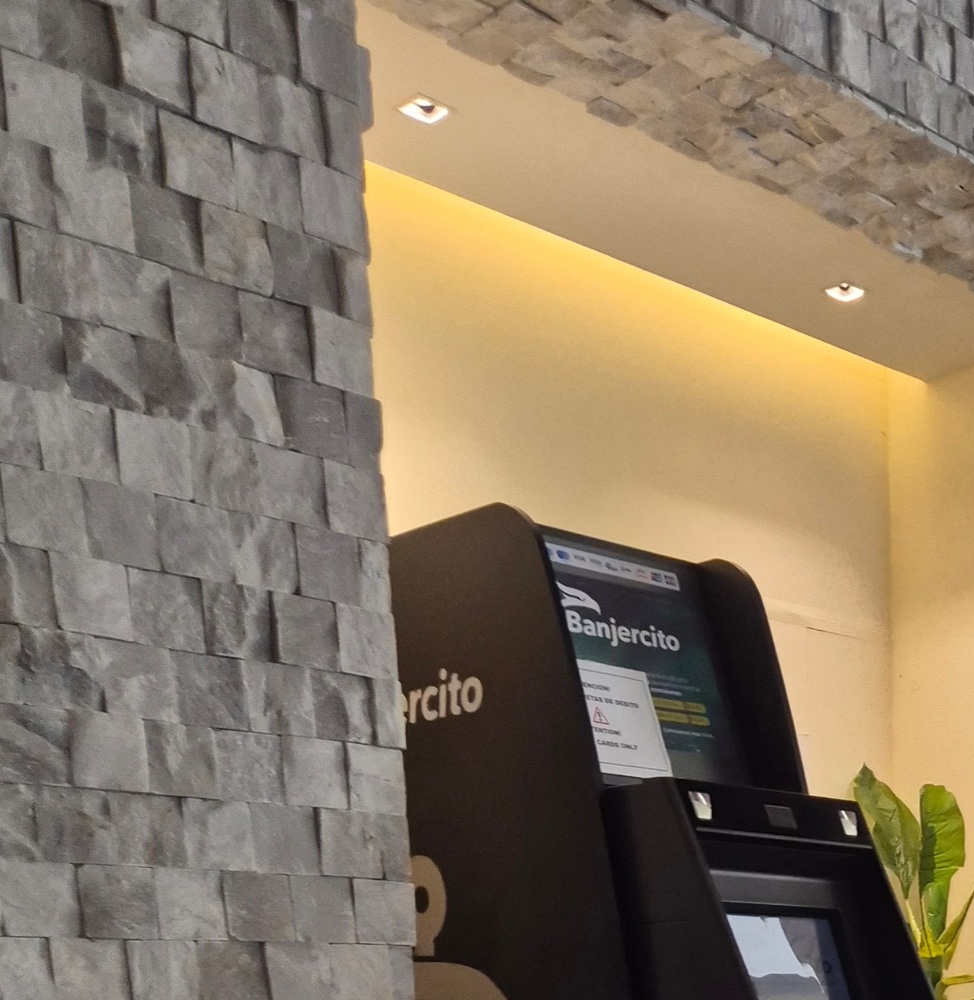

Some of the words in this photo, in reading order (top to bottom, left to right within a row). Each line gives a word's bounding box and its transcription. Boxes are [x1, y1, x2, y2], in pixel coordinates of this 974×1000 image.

[565, 609, 681, 652] Banjercito
[401, 667, 484, 724] rcito
[597, 739, 620, 748] CARDS
[620, 743, 639, 751] ONLY
